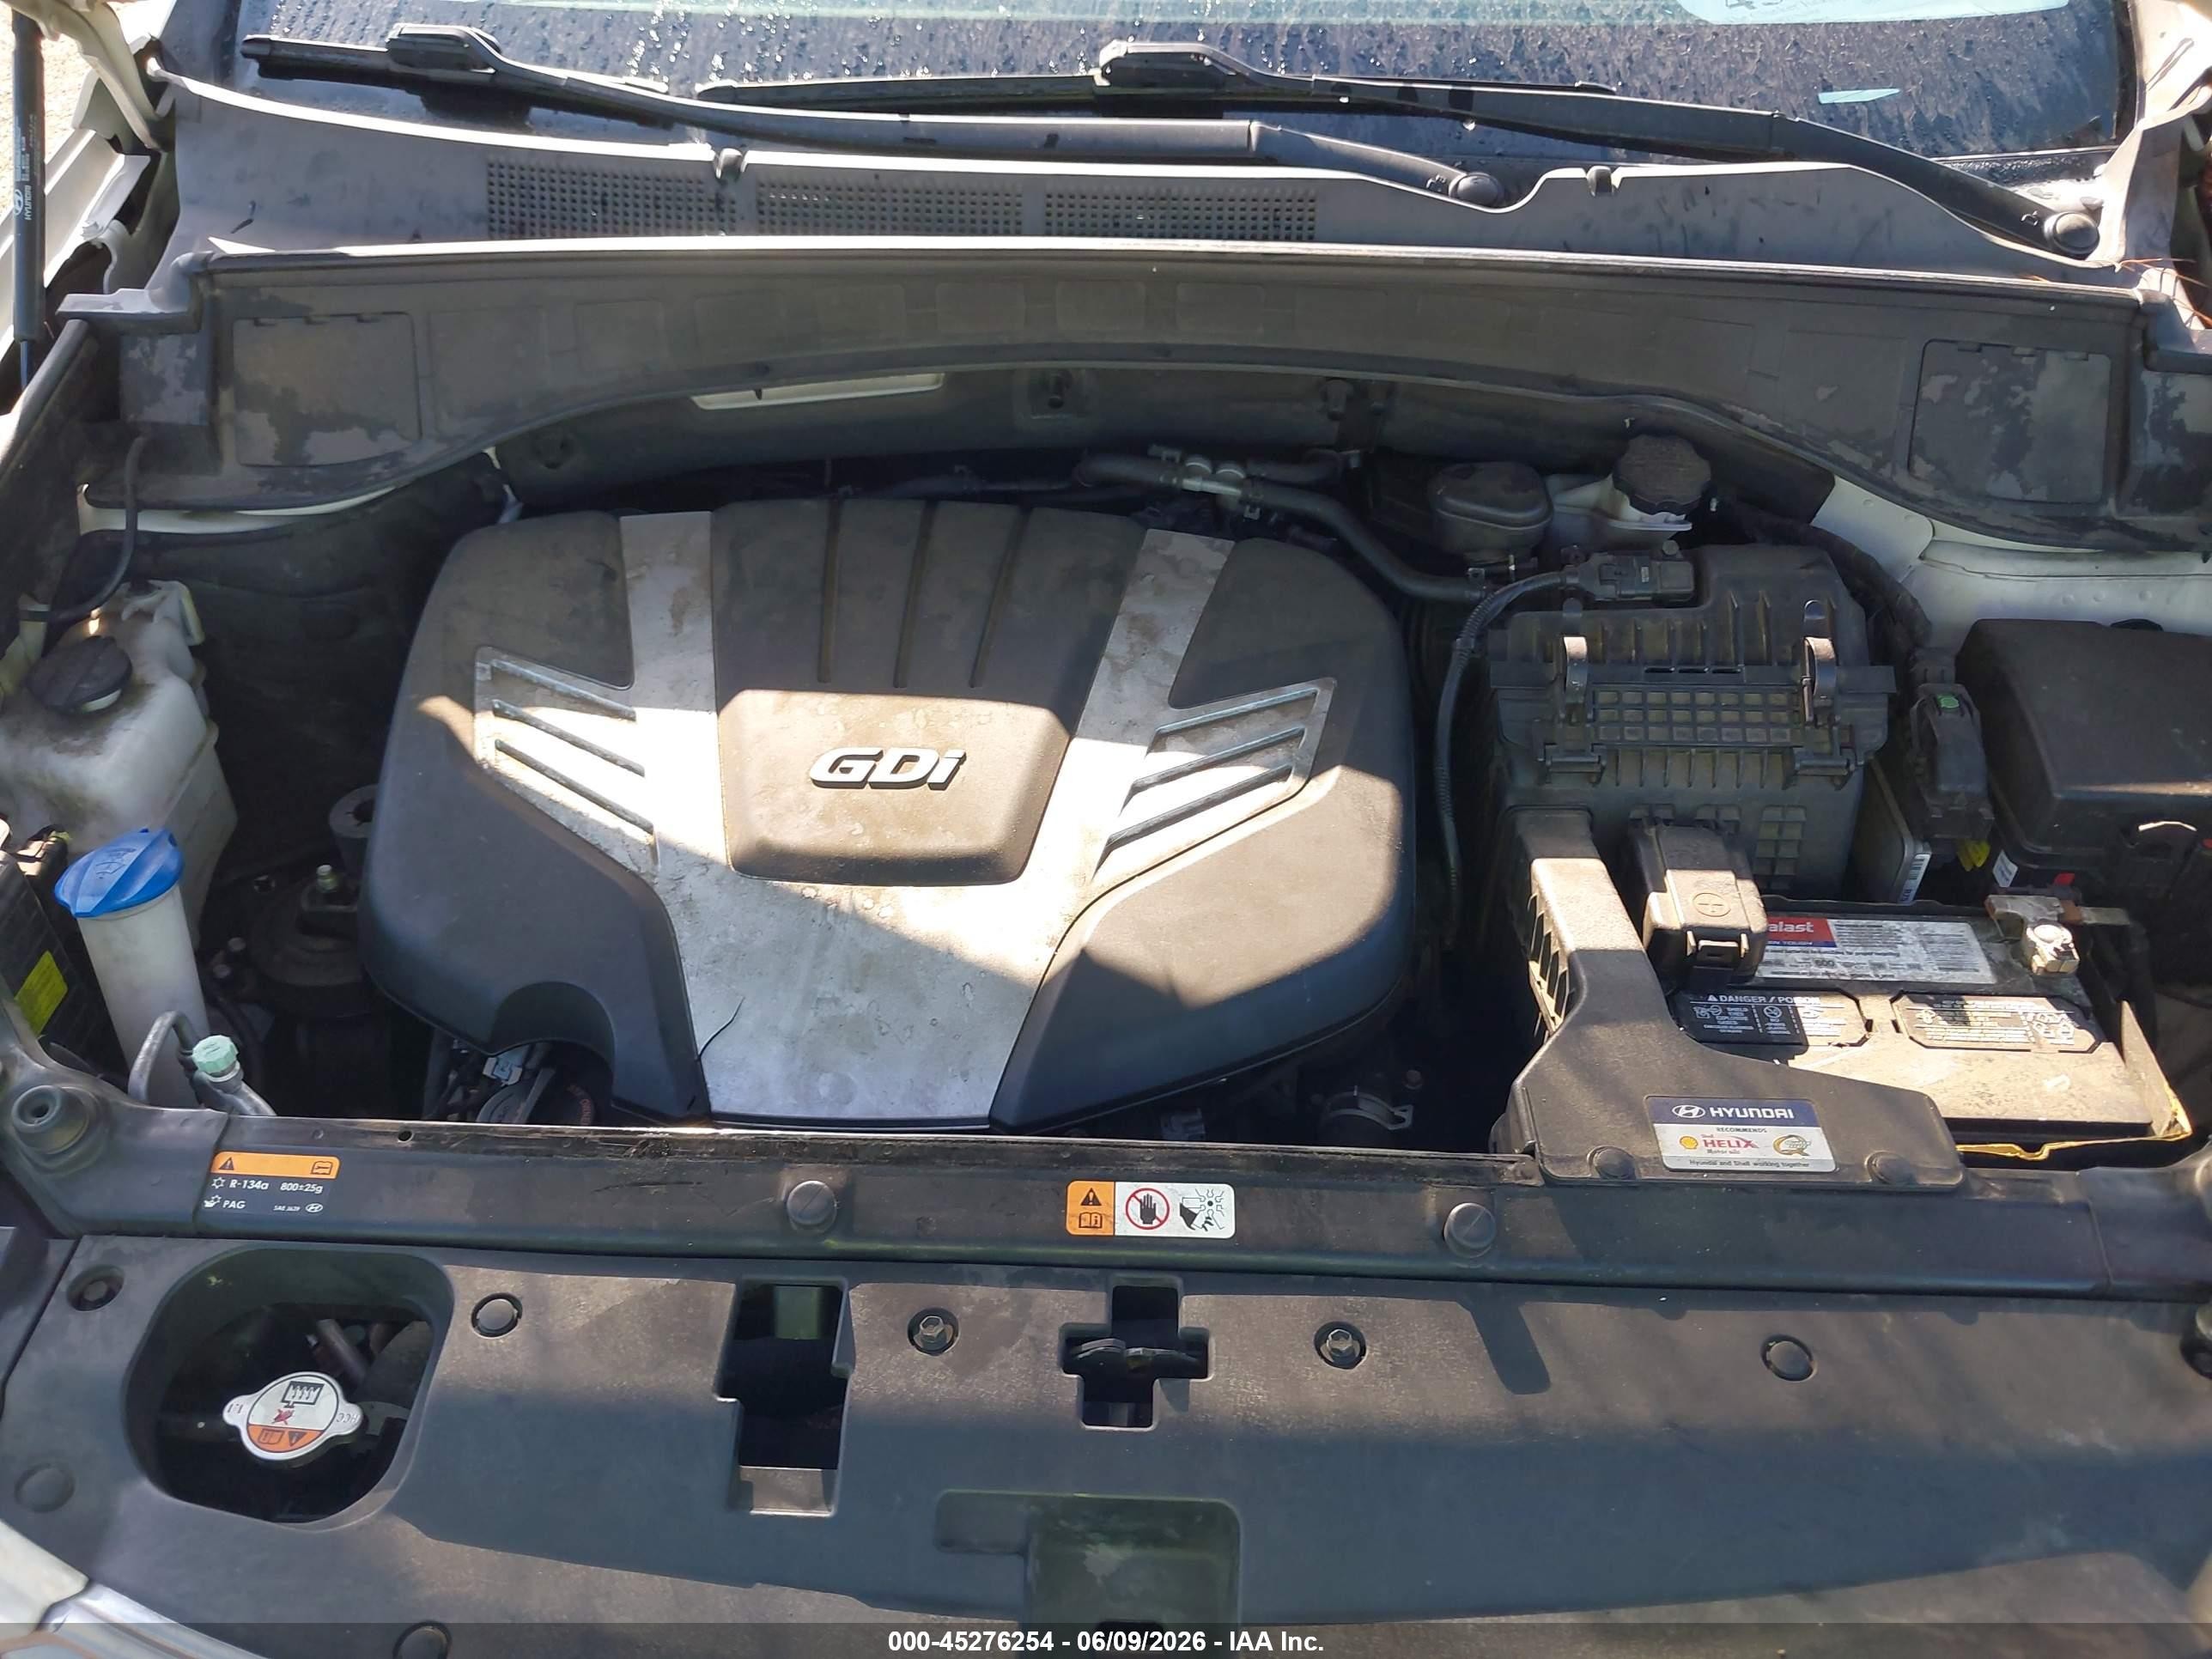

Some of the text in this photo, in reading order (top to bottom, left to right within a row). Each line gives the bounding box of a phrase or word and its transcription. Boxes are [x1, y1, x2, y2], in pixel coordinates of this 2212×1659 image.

[809, 747, 967, 791] GDi
[1768, 921, 1814, 933] alast
[1719, 994, 1766, 1003] DANGER
[1709, 1107, 1796, 1119] HYUNDAI
[1704, 1139, 1759, 1149] HELIX
[228, 1179, 270, 1190] R-134a
[222, 1200, 246, 1209] PAG
